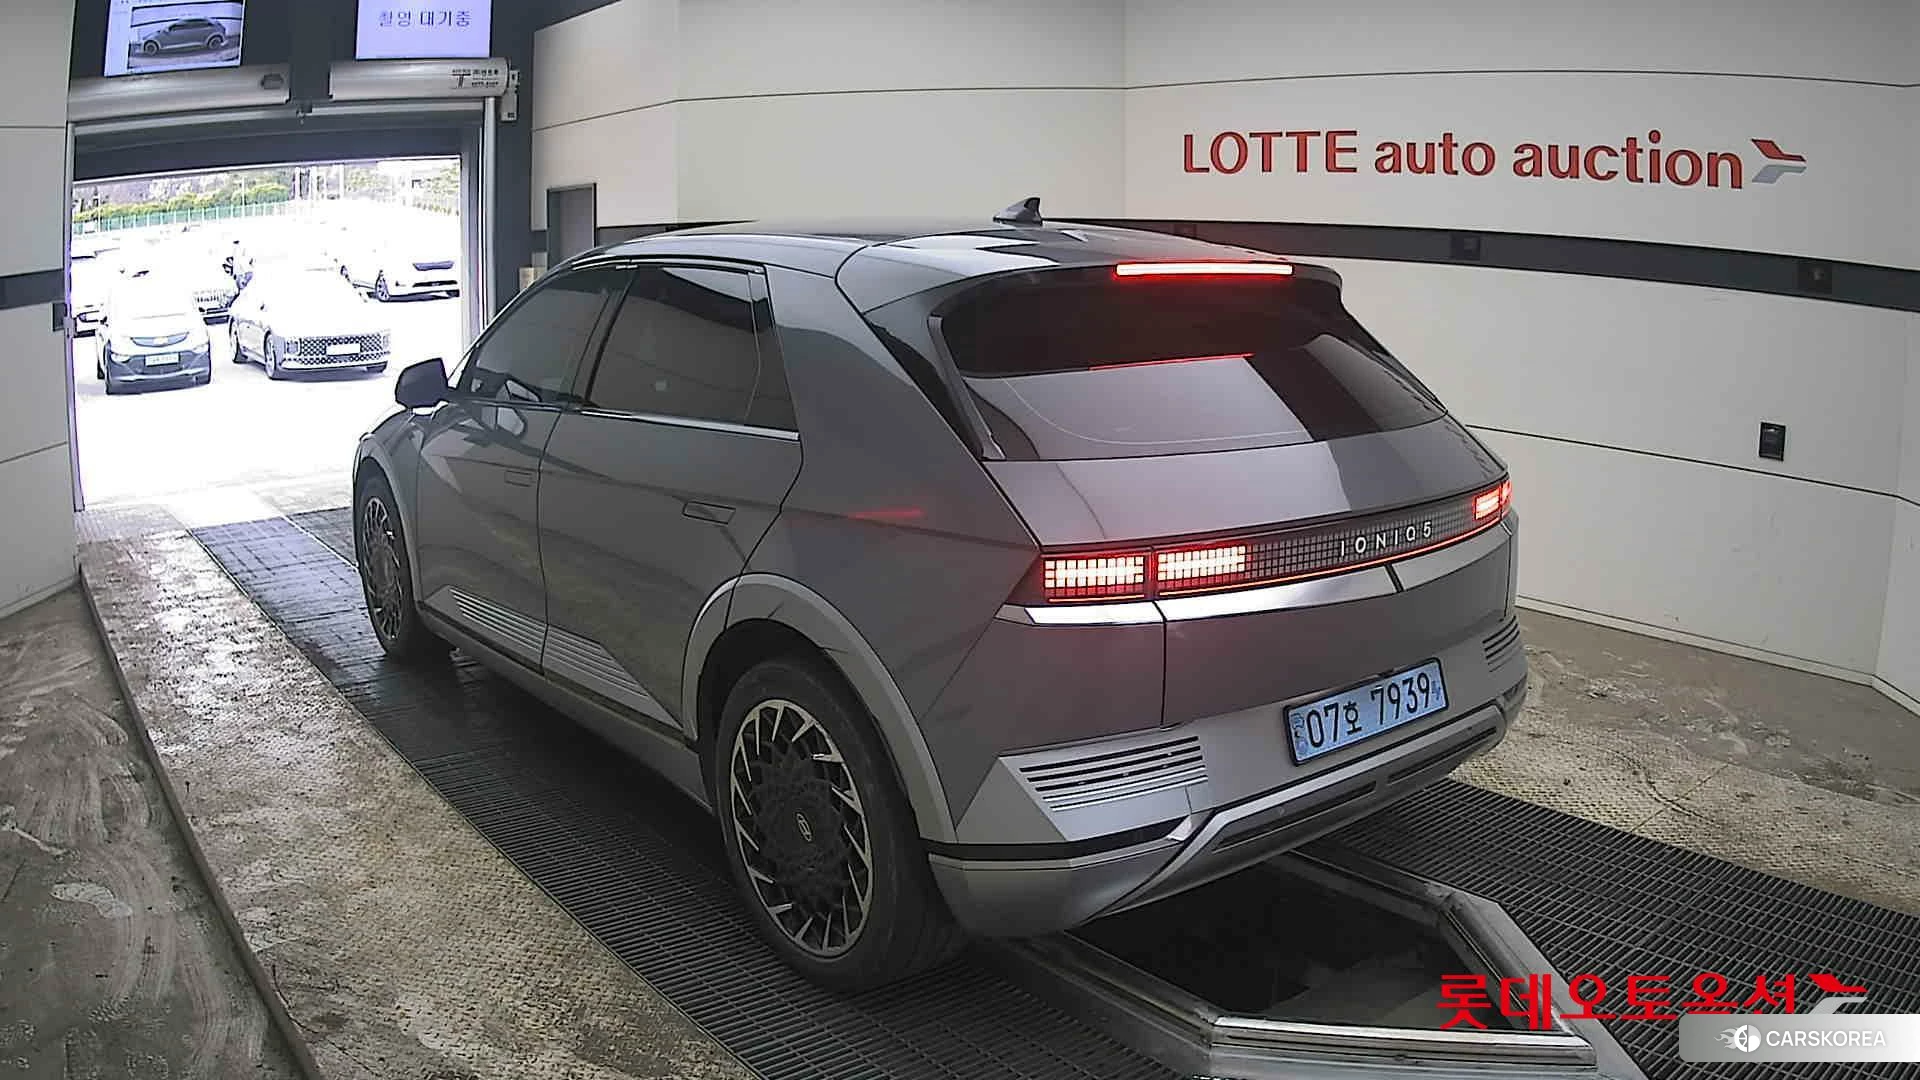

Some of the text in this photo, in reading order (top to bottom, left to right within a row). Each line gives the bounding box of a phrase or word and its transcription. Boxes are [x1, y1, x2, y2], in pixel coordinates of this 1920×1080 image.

[420, 10, 472, 27] 대기중
[1183, 129, 1743, 190] LOTTE auto auction
[1305, 672, 1431, 749] 07호 7939
